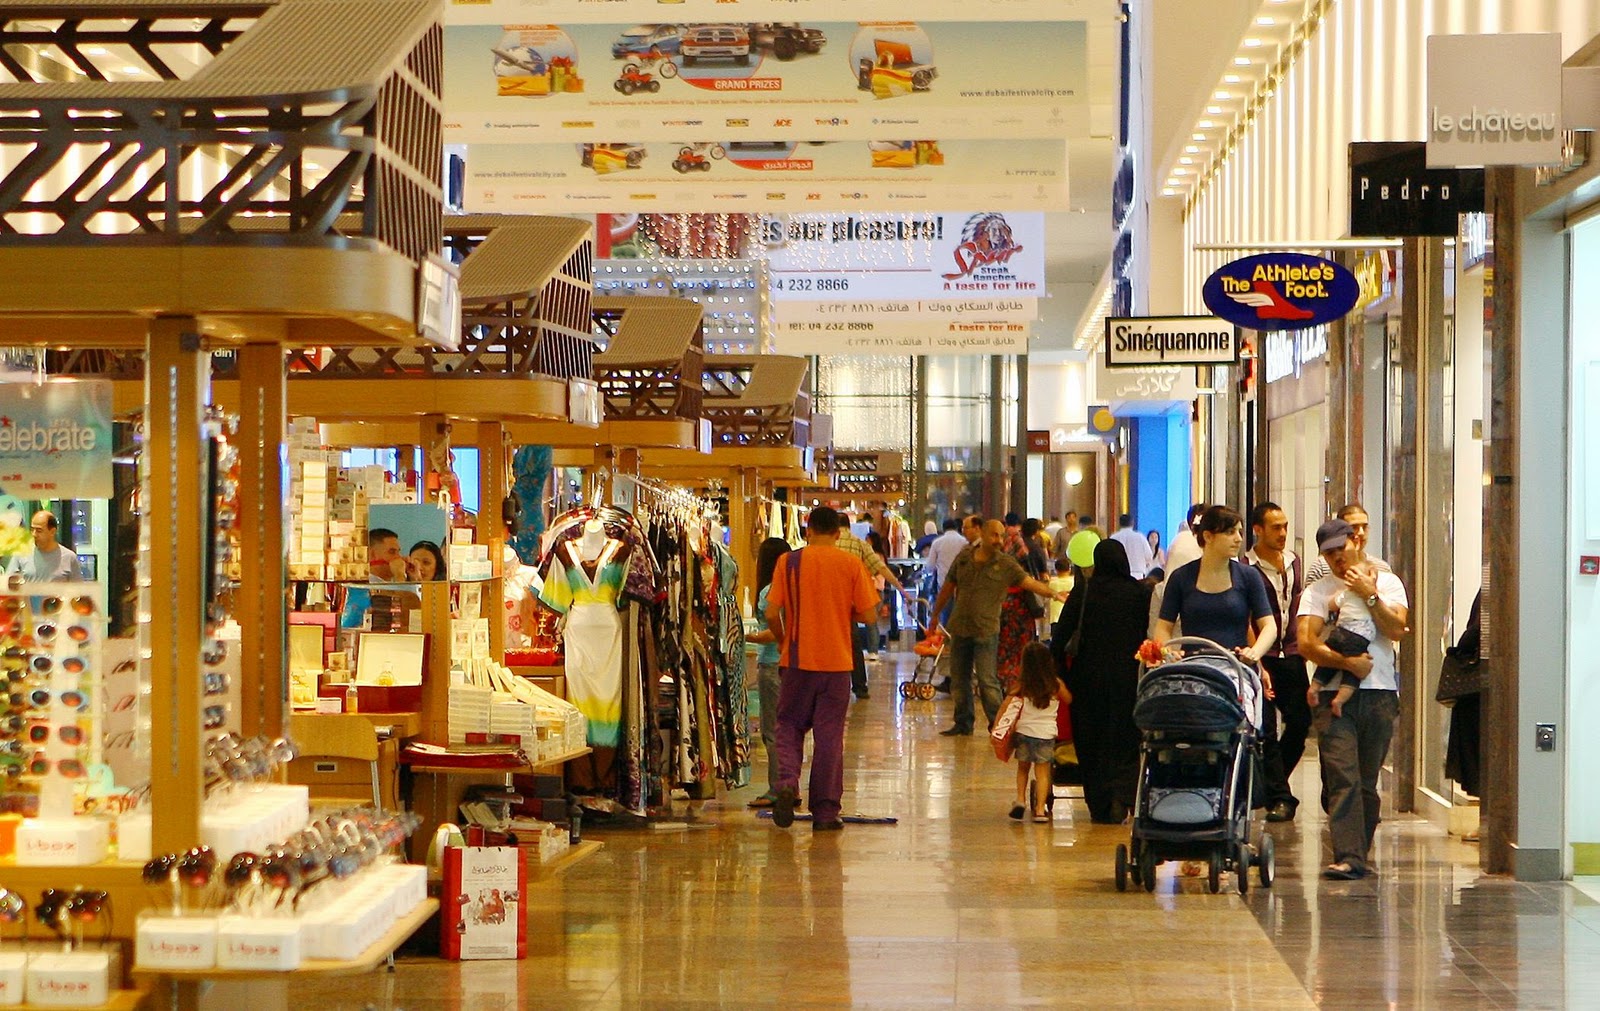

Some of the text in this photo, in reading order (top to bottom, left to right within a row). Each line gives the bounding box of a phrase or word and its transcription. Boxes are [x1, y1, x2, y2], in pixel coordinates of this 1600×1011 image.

[714, 80, 780, 90] GRAND PRIZES
[960, 89, 1074, 98] www.dubaifestivalcity.com
[773, 119, 792, 127] ACE
[1433, 104, 1555, 132] le château
[1361, 177, 1450, 200] Pedro
[762, 216, 943, 243] is our pleasure!
[980, 266, 1009, 274] Steak
[788, 279, 813, 291] 232
[816, 278, 849, 291] 8866
[1221, 263, 1335, 298] The Athlete's Foot.
[943, 282, 1037, 291] A taste for life
[825, 323, 845, 331] 232
[848, 323, 874, 331] 8866
[949, 323, 1024, 331] A taste for life
[1115, 326, 1230, 359] Sinéquanone
[1116, 375, 1176, 397] كلاركس
